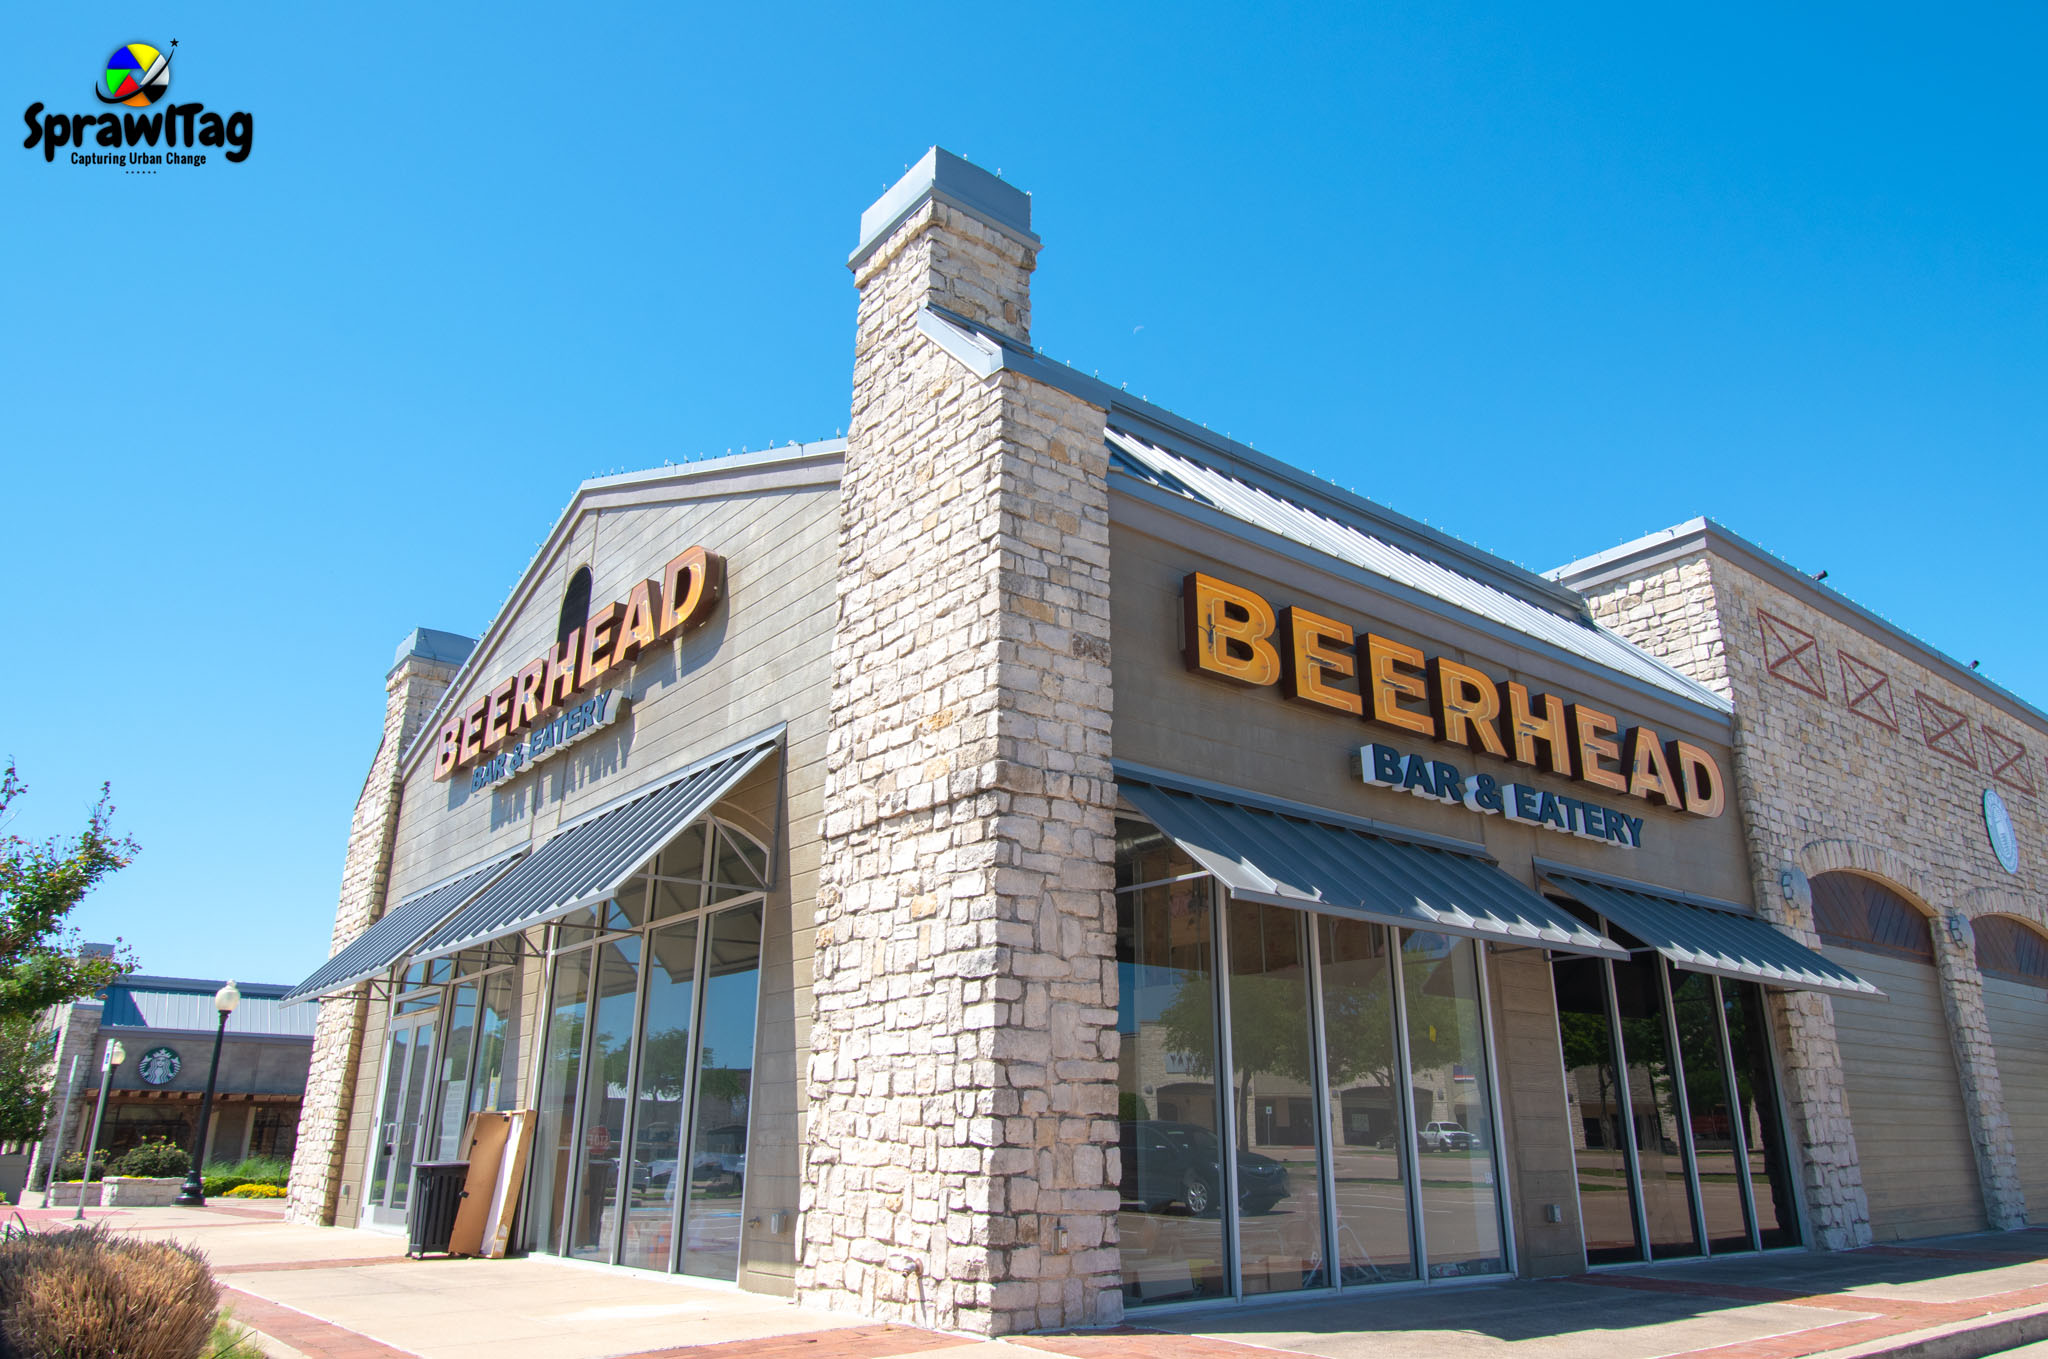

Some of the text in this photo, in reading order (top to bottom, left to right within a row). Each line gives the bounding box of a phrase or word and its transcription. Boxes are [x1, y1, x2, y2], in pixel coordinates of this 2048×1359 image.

[433, 545, 720, 783] BEERHEAD
[471, 689, 618, 794] BAR & EATERY
[1185, 571, 1725, 818] BEERHEAD
[1367, 743, 1644, 849] BAR & EATERY
